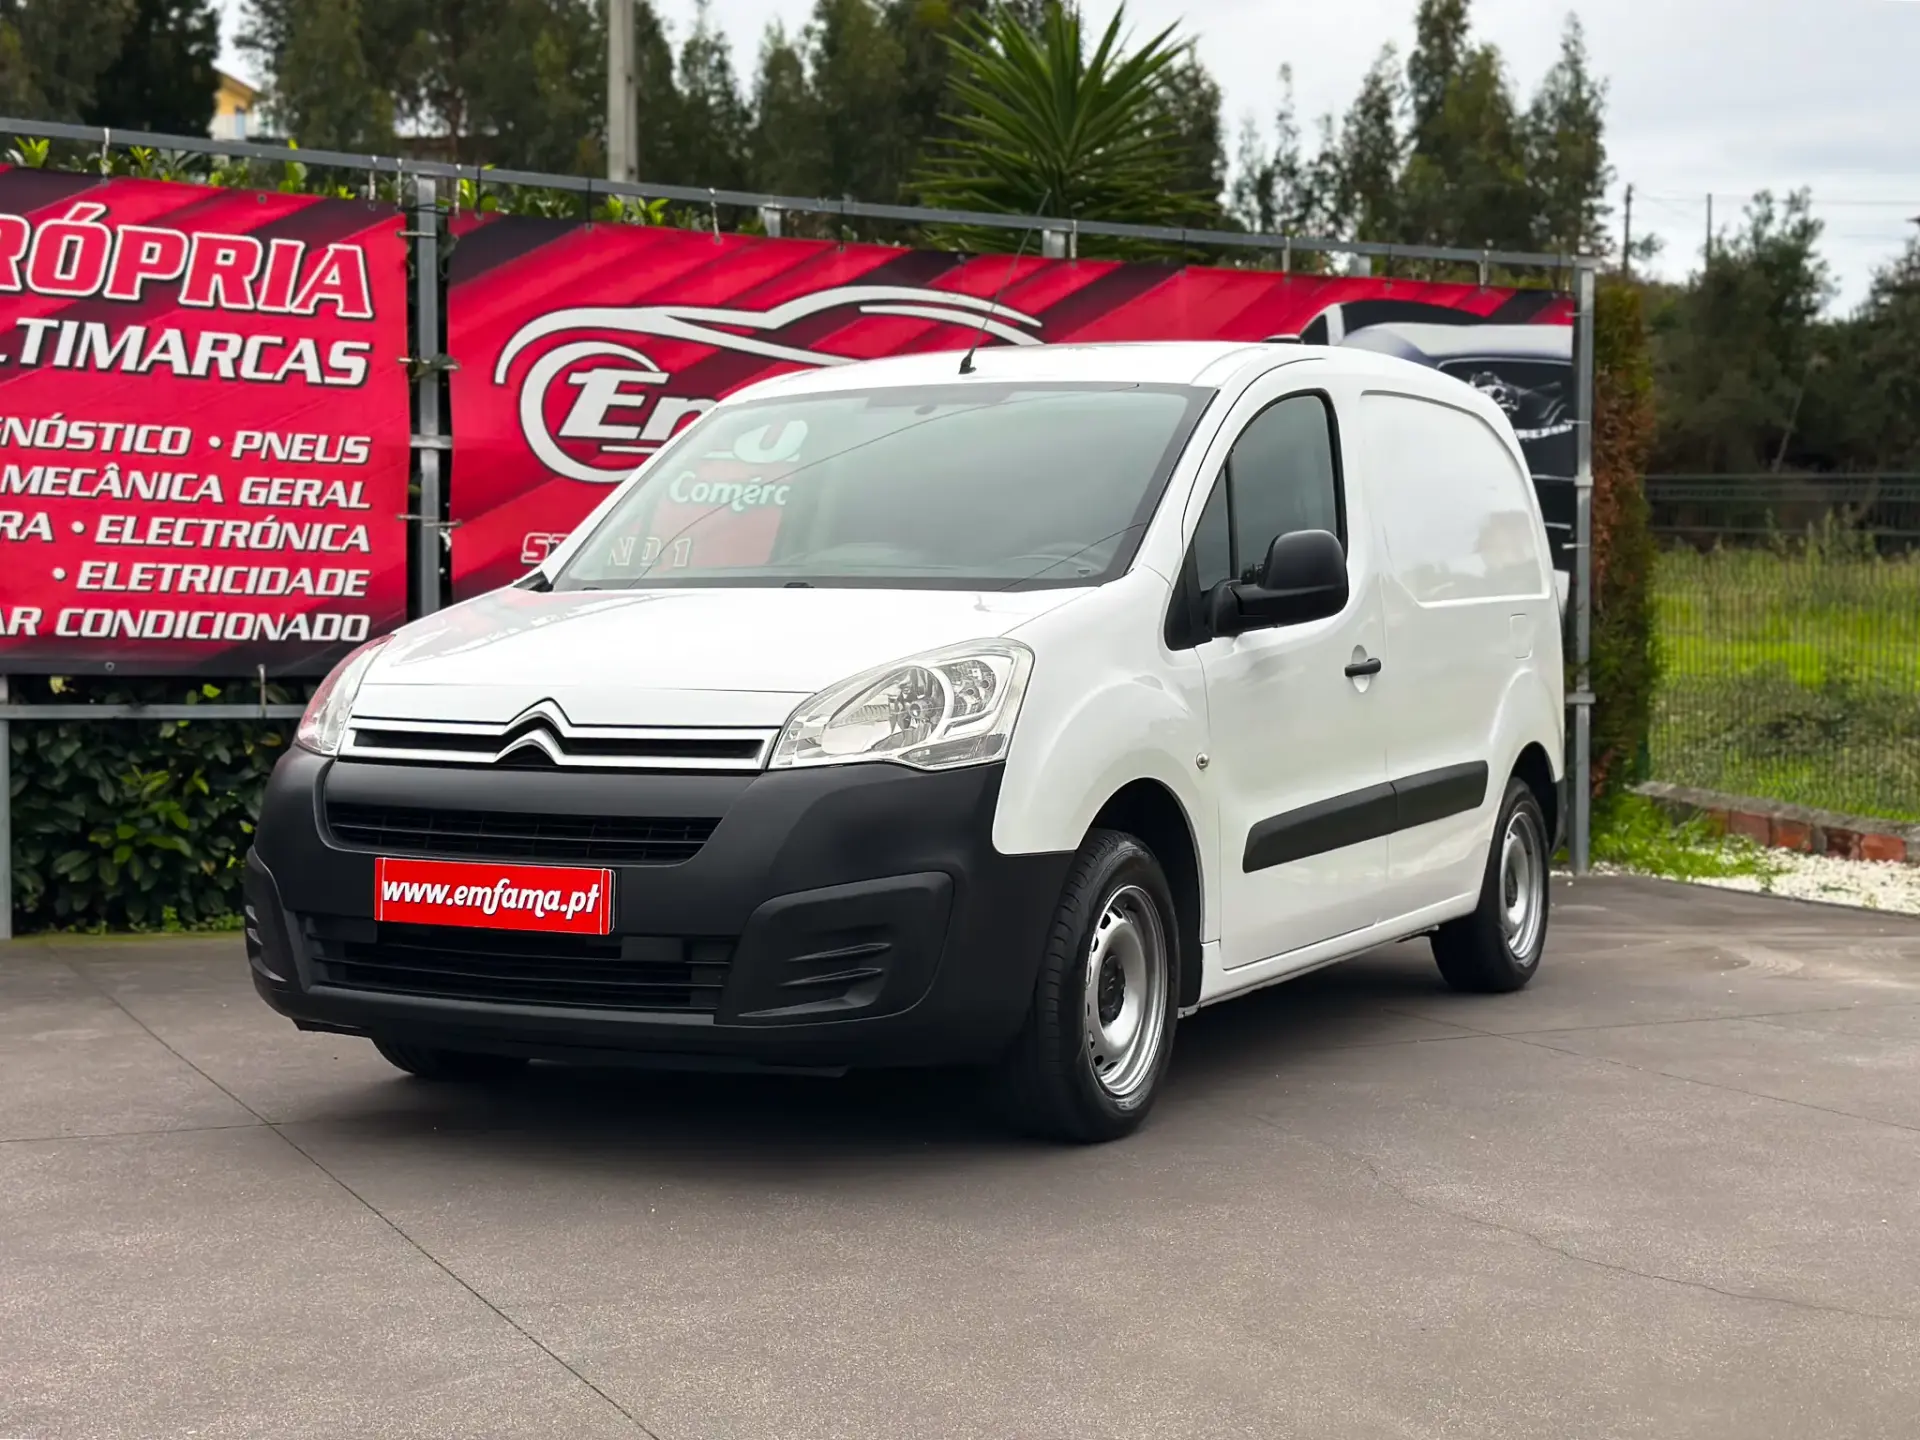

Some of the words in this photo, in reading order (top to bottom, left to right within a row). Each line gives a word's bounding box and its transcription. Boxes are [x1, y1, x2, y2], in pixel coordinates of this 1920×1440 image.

[0, 317, 371, 386] TIMARCAS
[0, 413, 191, 455] NÓSTICO
[231, 430, 371, 463] PNEUS
[0, 463, 223, 503] MECÂNICA
[238, 475, 371, 509] GERAL
[94, 514, 370, 552] ELECTRÓNICA
[76, 560, 370, 598] ELETRICIDADE
[0, 606, 42, 636] R
[55, 607, 370, 642] CONDICIONADO
[382, 878, 600, 920] www.emfama.pt
